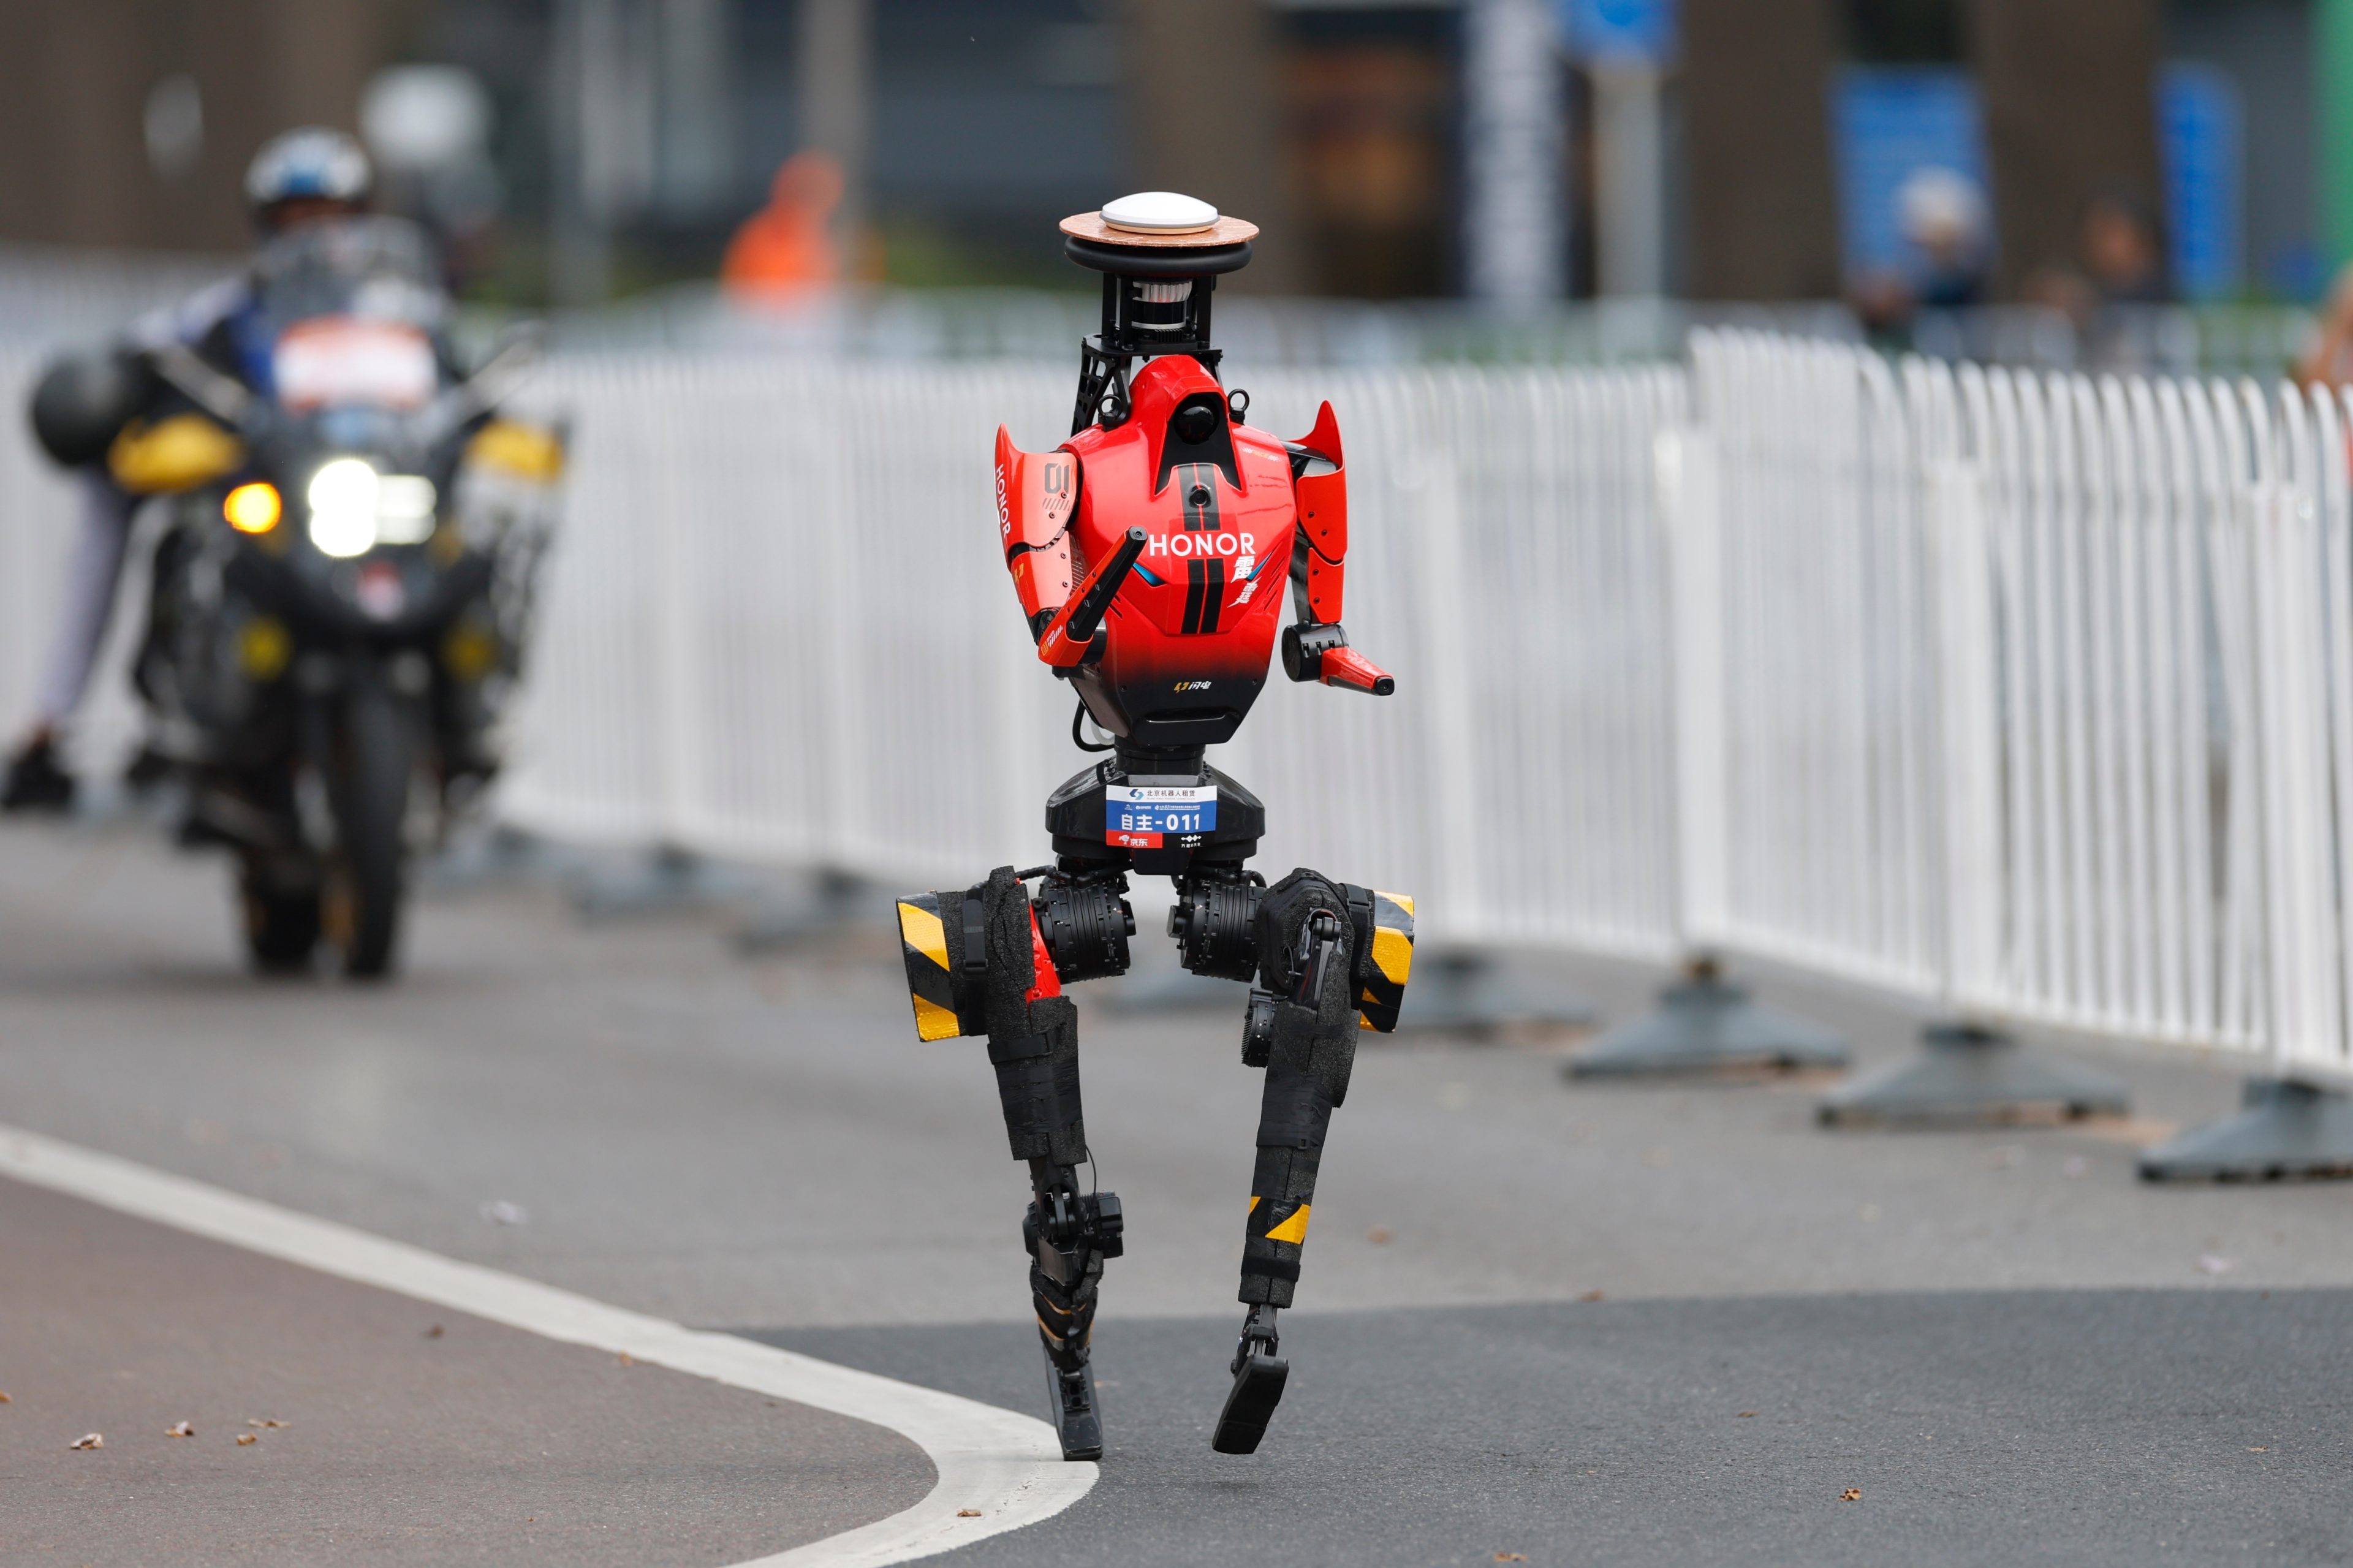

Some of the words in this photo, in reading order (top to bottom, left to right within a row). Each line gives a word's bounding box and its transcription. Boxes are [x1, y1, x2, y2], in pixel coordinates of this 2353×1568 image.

[1044, 463, 1069, 494] 01
[996, 463, 1010, 538] HONOR
[1149, 532, 1256, 557] HONOR
[1188, 680, 1212, 691] 闪电
[1121, 813, 1200, 831] 自主-011
[1129, 838, 1148, 847] 京东
